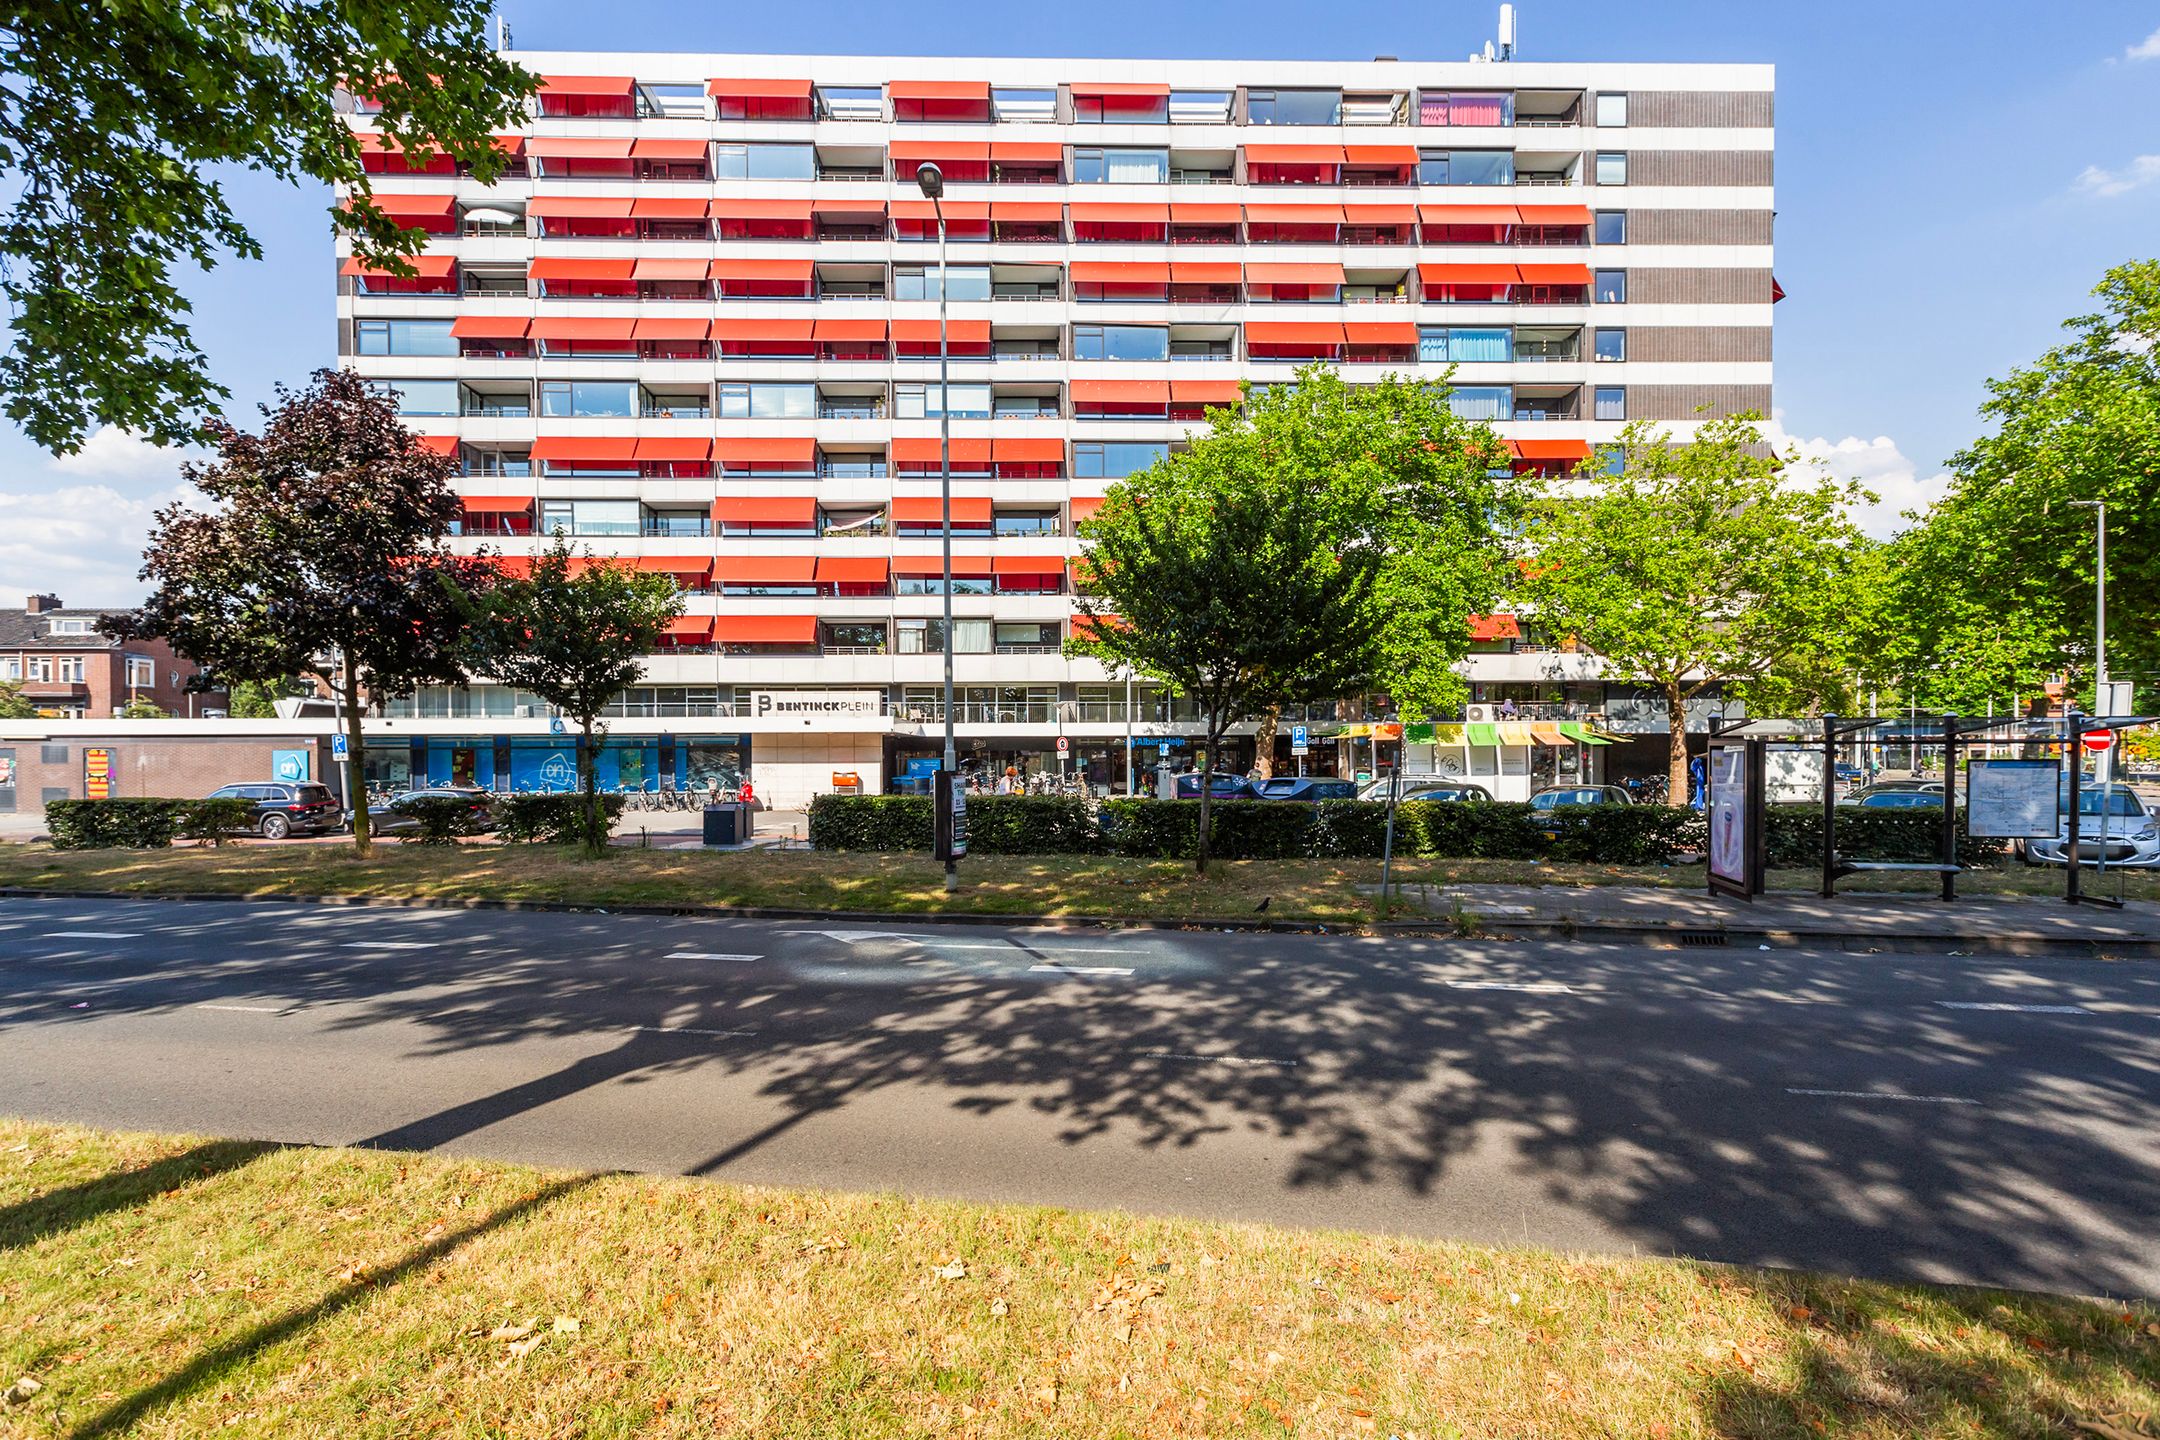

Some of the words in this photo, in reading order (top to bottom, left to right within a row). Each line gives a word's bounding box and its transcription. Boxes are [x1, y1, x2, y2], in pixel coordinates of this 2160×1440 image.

[776, 702, 873, 711] BENTINCKPLEIN
[1295, 729, 1304, 739] P
[335, 736, 344, 746] P
[1137, 737, 1162, 746] Albert
[1165, 737, 1185, 747] Heijn
